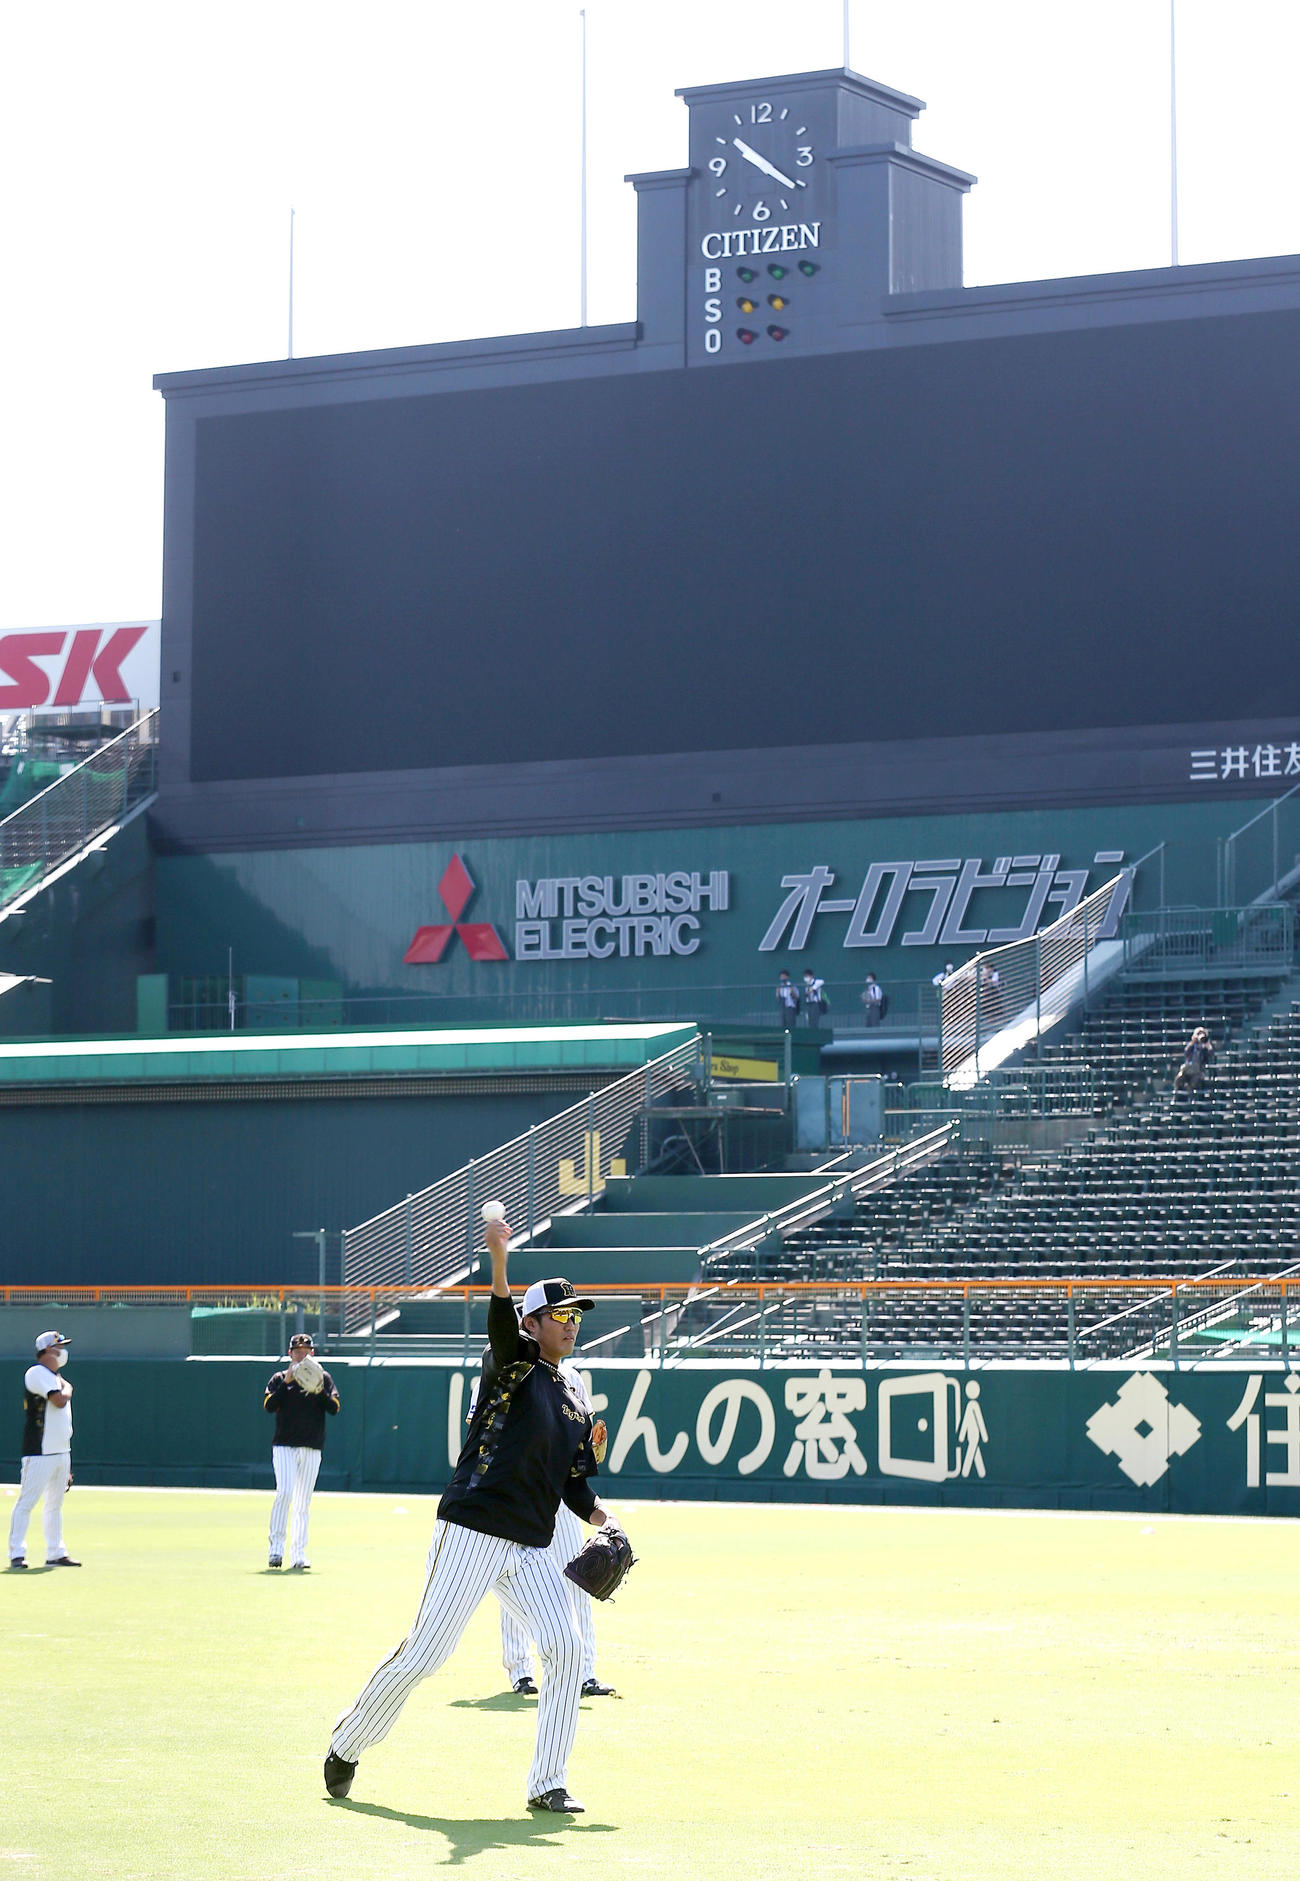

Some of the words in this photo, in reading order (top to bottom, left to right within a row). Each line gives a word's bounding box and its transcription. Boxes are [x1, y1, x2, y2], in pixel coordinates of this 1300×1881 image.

[751, 103, 773, 124] 12
[708, 157, 728, 178] 9
[795, 146, 814, 167] 3
[752, 201, 771, 221] 6
[701, 222, 821, 259] CITIZEN
[704, 268, 722, 293] B
[704, 298, 722, 323] S
[516, 870, 729, 919] MITSUBISHI
[515, 915, 700, 960] ELECTRIC
